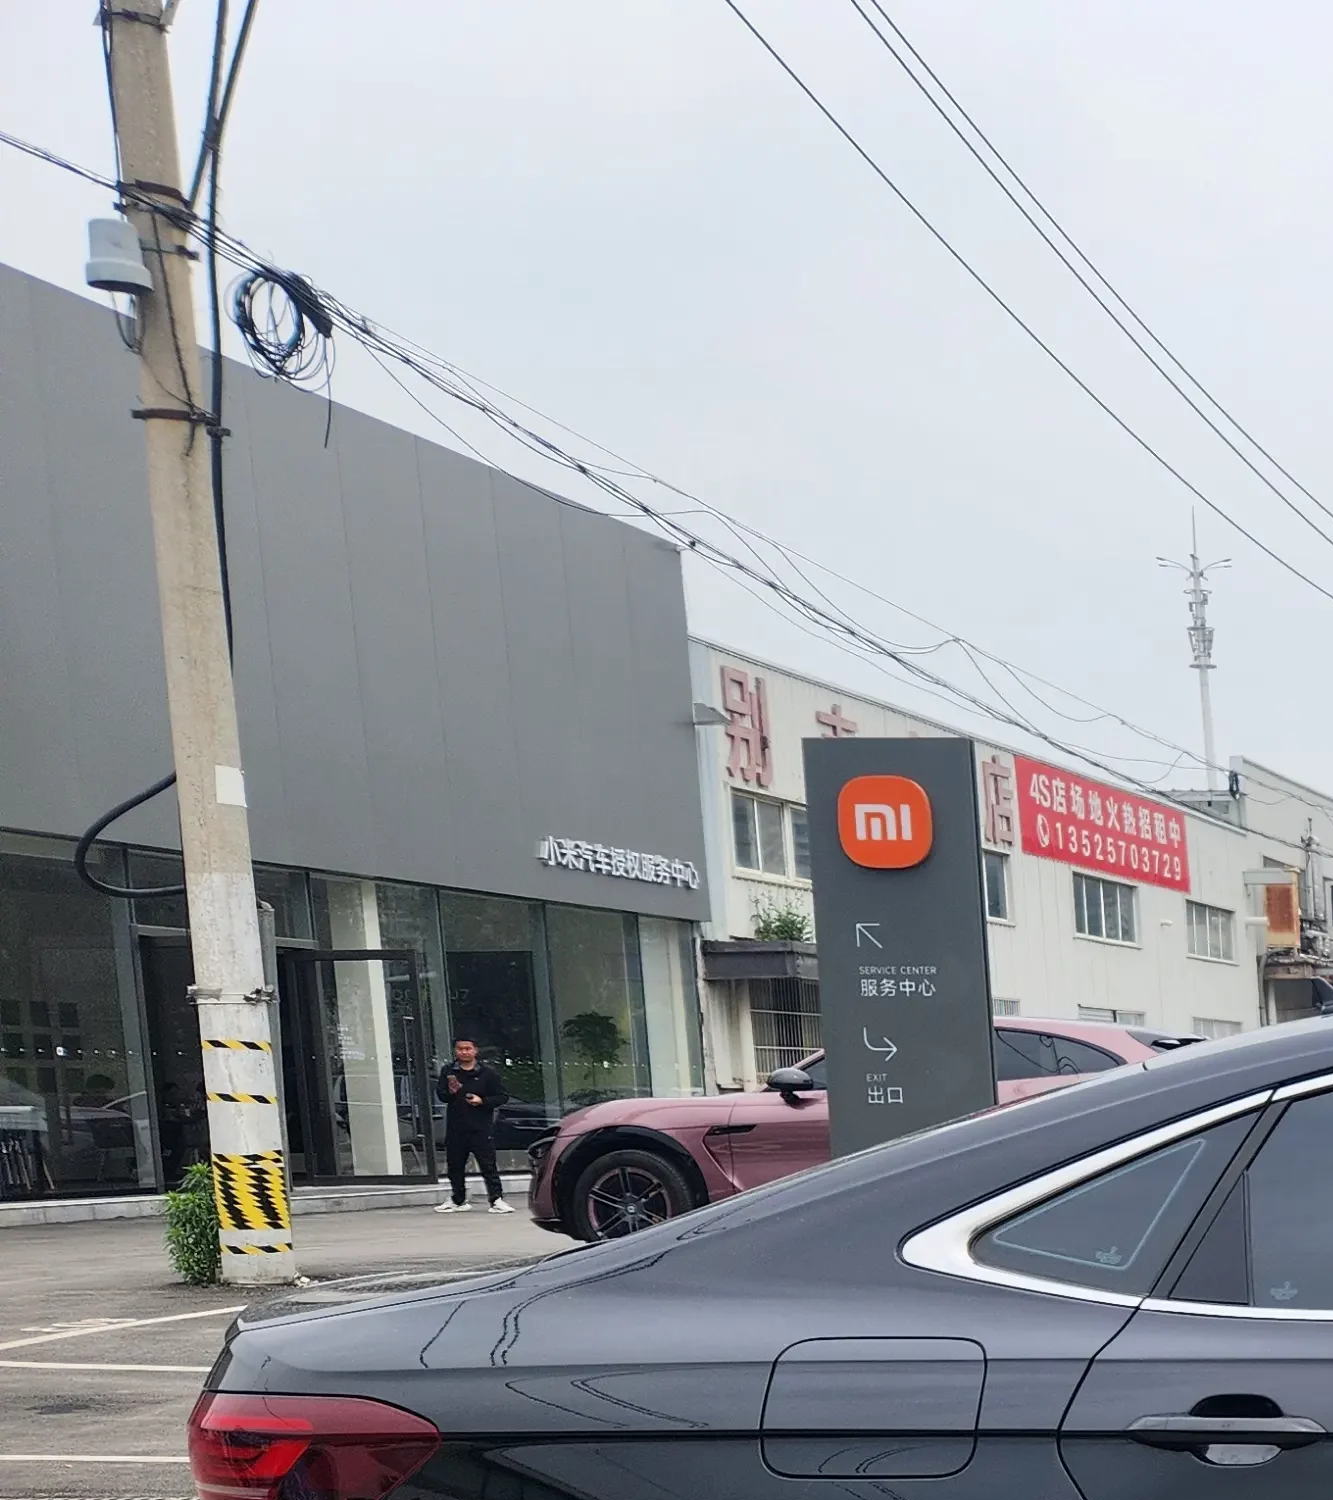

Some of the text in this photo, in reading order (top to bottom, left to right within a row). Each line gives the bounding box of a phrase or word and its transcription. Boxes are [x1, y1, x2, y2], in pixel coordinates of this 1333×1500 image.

[1029, 773, 1182, 848] 4S店场地火热招租中
[1055, 822, 1182, 881] 13525703729
[537, 836, 700, 889] 小米汽车授权服务中心
[859, 966, 937, 975] SERVICE CENTER
[860, 978, 937, 997] 服务中心
[866, 1073, 888, 1082] EXIT
[867, 1085, 904, 1104] 出口
